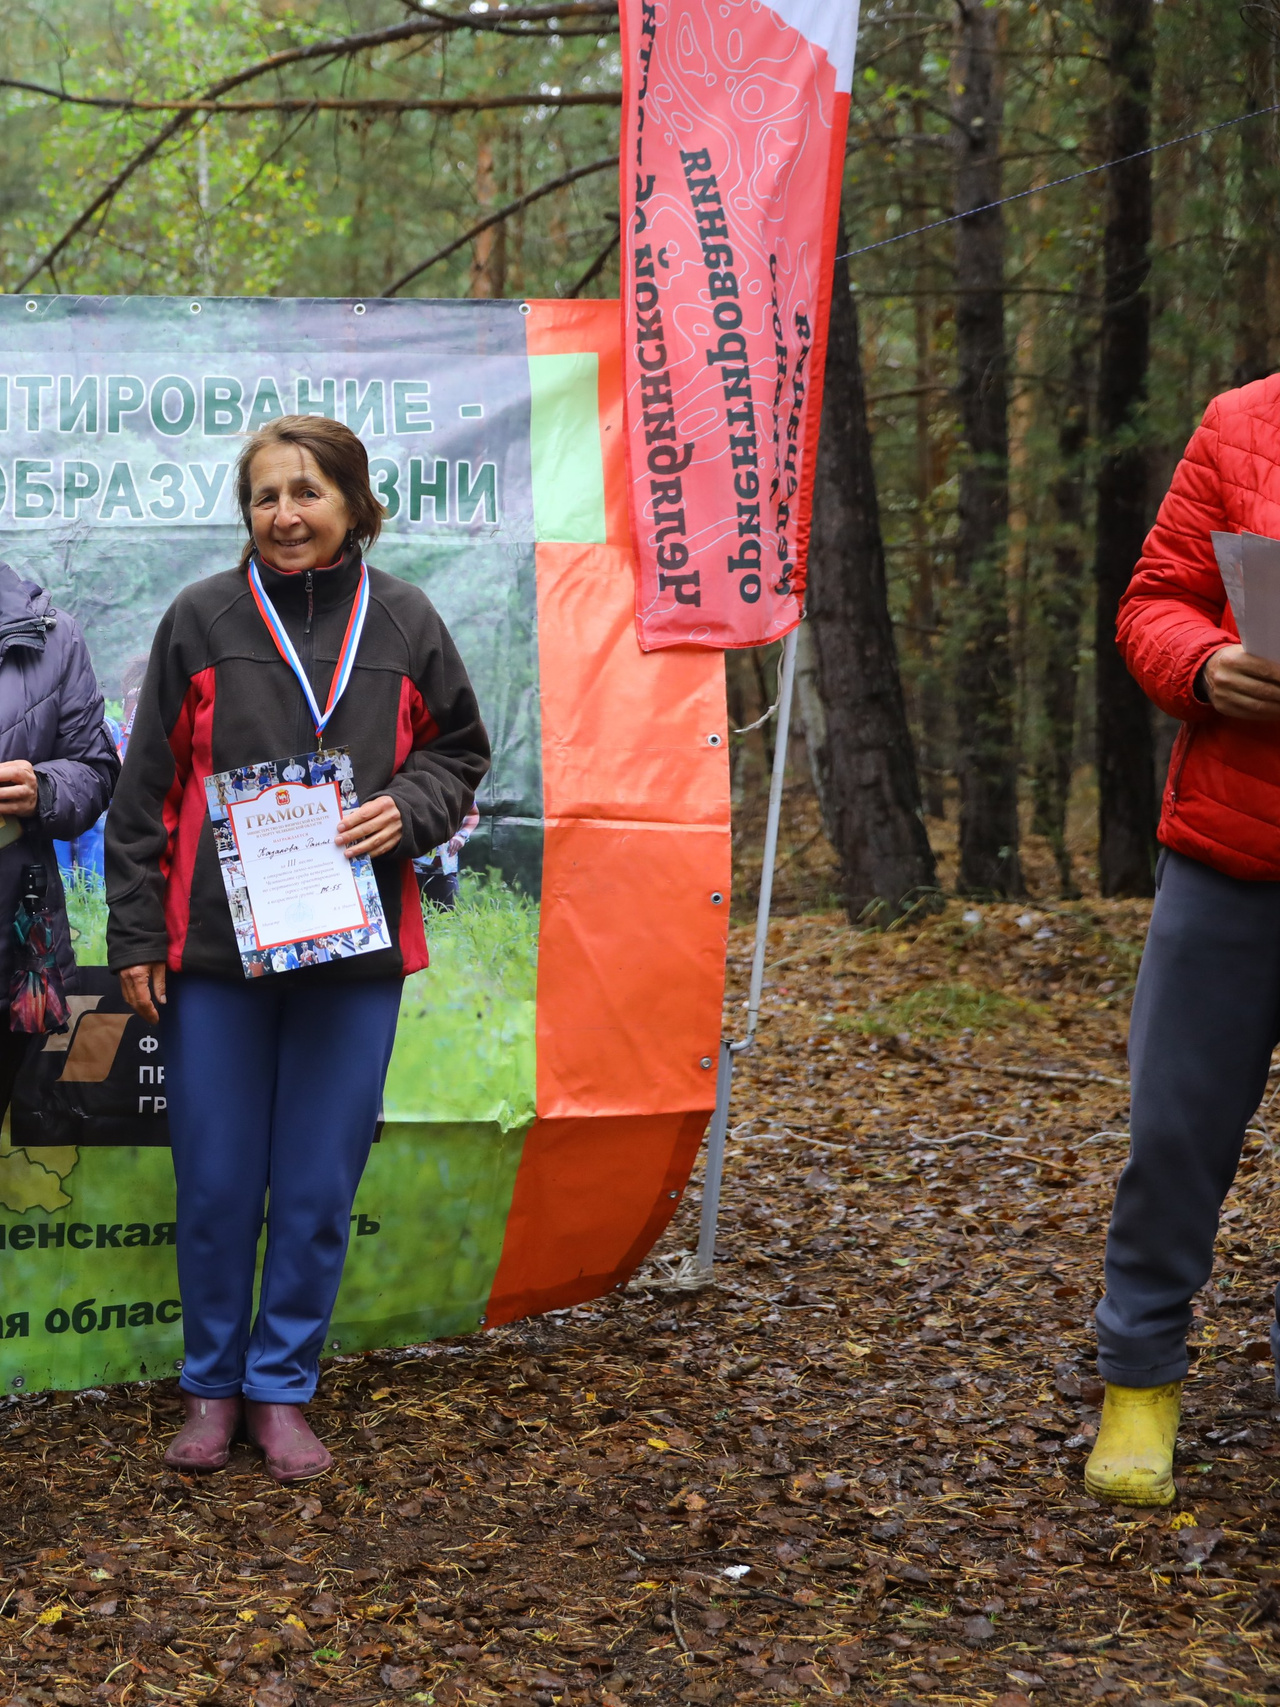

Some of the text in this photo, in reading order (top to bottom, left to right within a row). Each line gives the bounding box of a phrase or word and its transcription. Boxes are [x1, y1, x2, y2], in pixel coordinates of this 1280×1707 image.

[368, 457, 498, 523] ЗНИ
[245, 802, 327, 829] ГРАМОТА
[44, 1298, 183, 1335] облас
